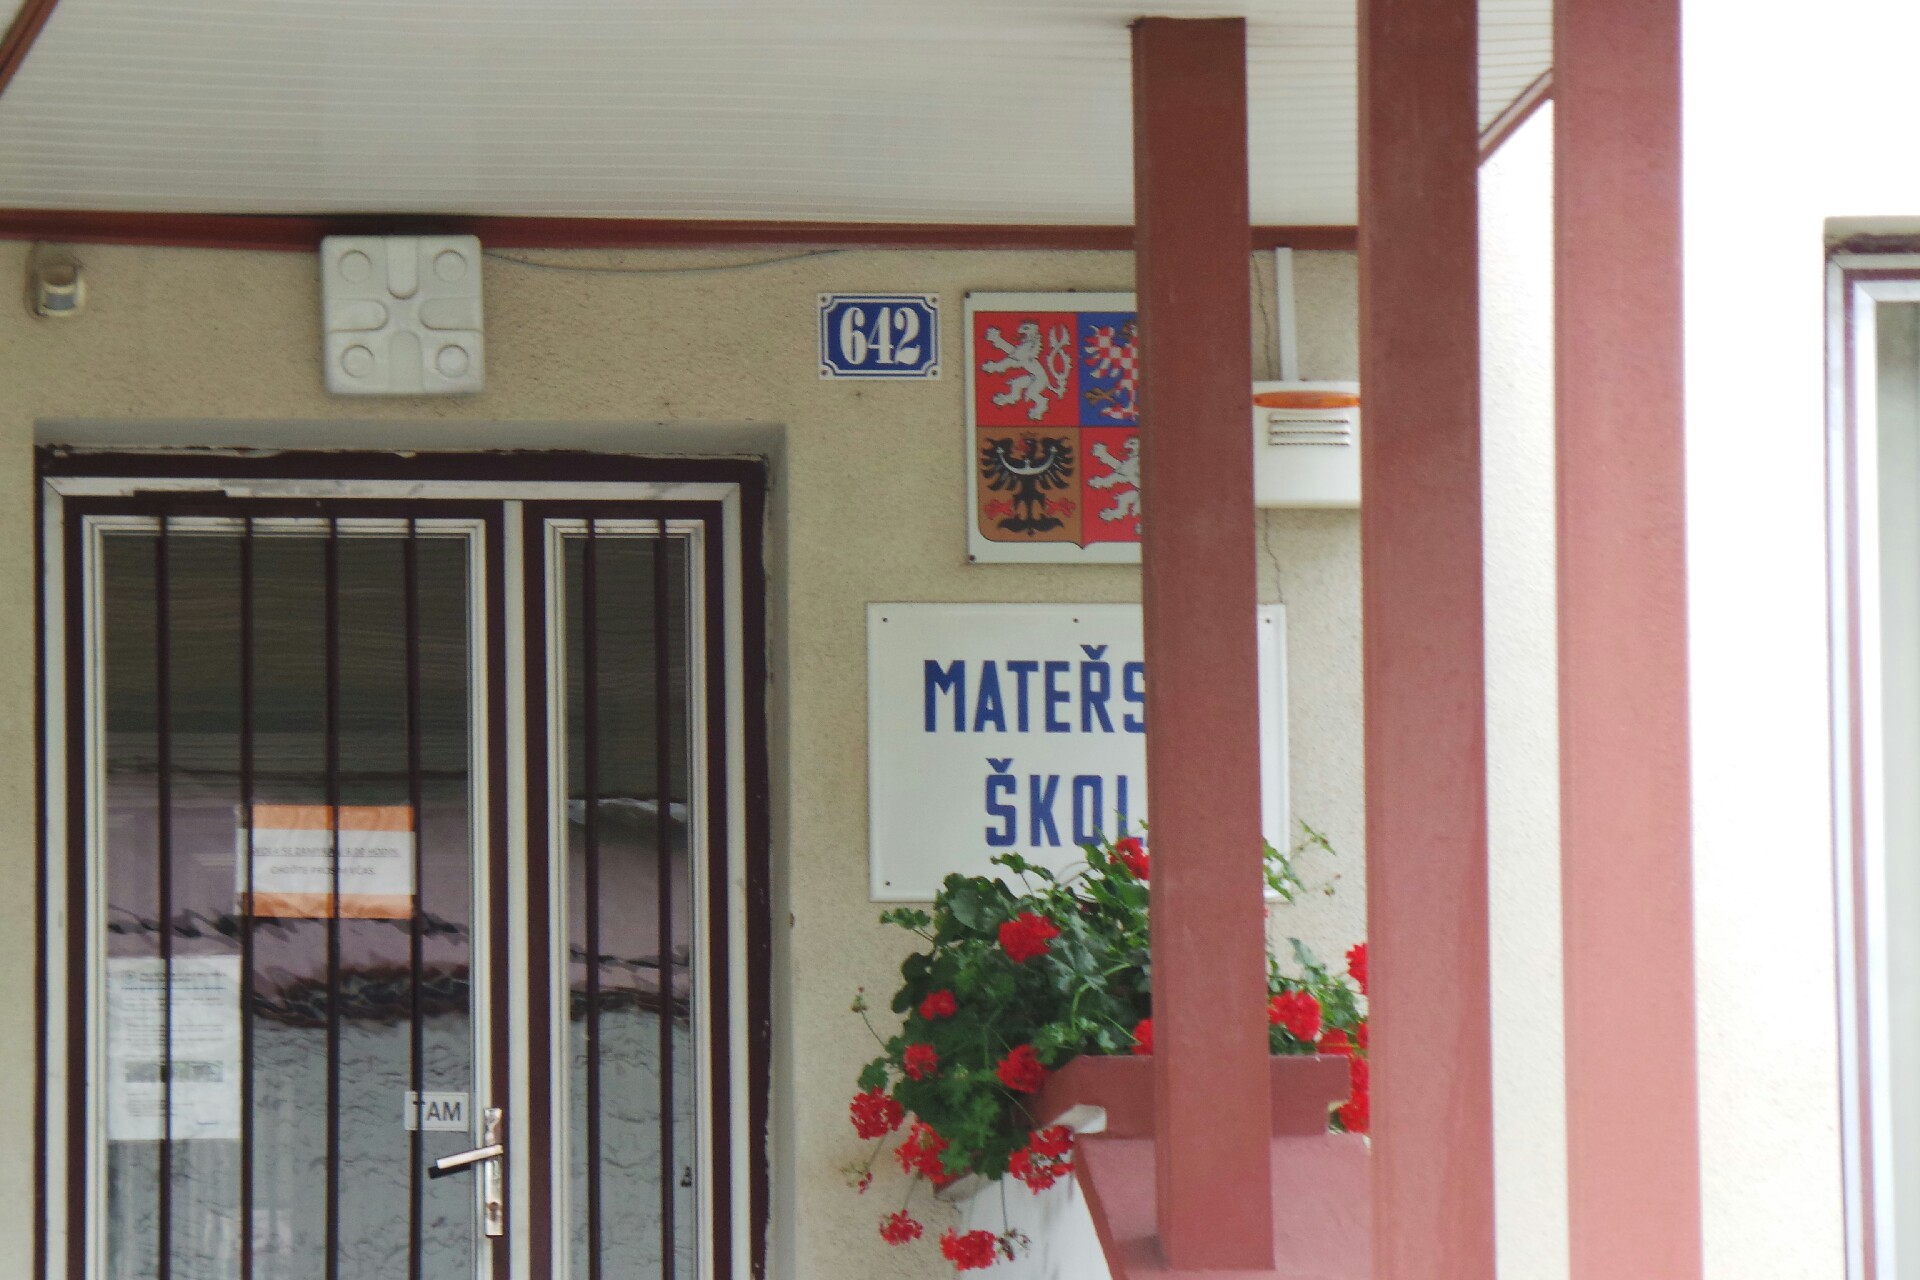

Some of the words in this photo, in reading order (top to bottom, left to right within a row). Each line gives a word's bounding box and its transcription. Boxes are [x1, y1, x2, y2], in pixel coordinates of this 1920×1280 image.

[840, 307, 921, 366] 642
[924, 644, 1147, 733] MATEŘS
[985, 758, 1144, 848] ŠKOL
